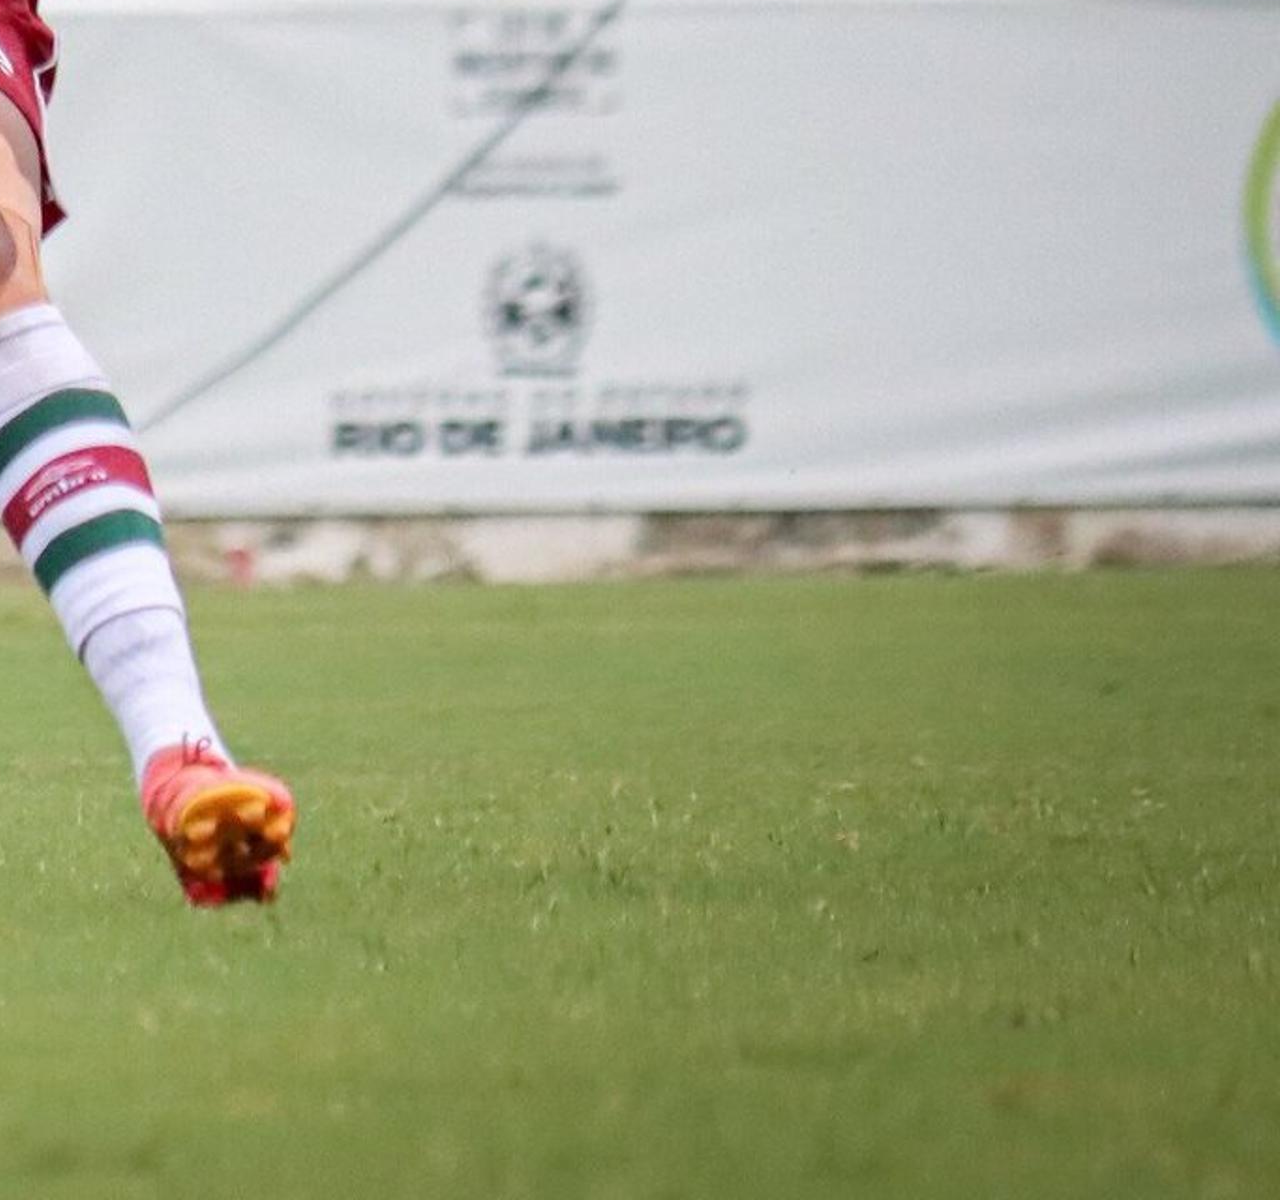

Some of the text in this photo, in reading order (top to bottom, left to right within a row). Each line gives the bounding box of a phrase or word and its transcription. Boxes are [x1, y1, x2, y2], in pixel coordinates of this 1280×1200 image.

[332, 415, 748, 456] RIO DE JANEIRO
